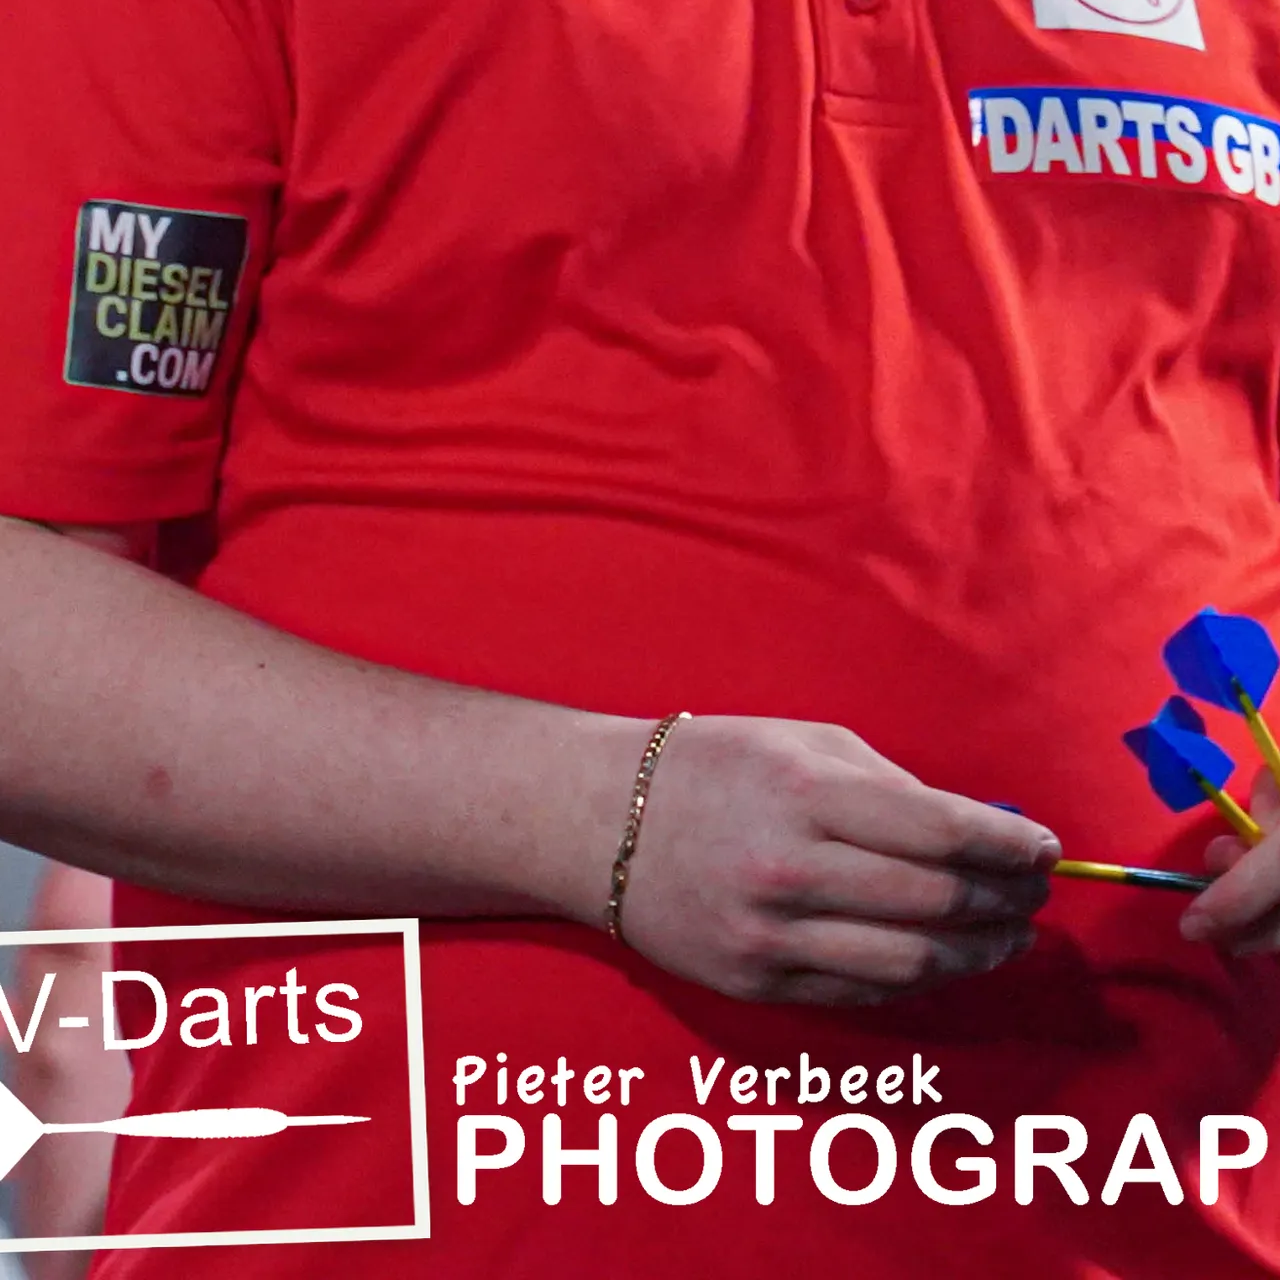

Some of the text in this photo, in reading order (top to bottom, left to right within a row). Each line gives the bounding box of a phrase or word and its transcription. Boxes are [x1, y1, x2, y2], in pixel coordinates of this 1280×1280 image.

[983, 96, 1208, 184] DARTS
[87, 207, 172, 259] MY
[84, 252, 229, 310] DIESEL
[95, 294, 228, 350] CLAIM
[116, 342, 216, 391] .COM
